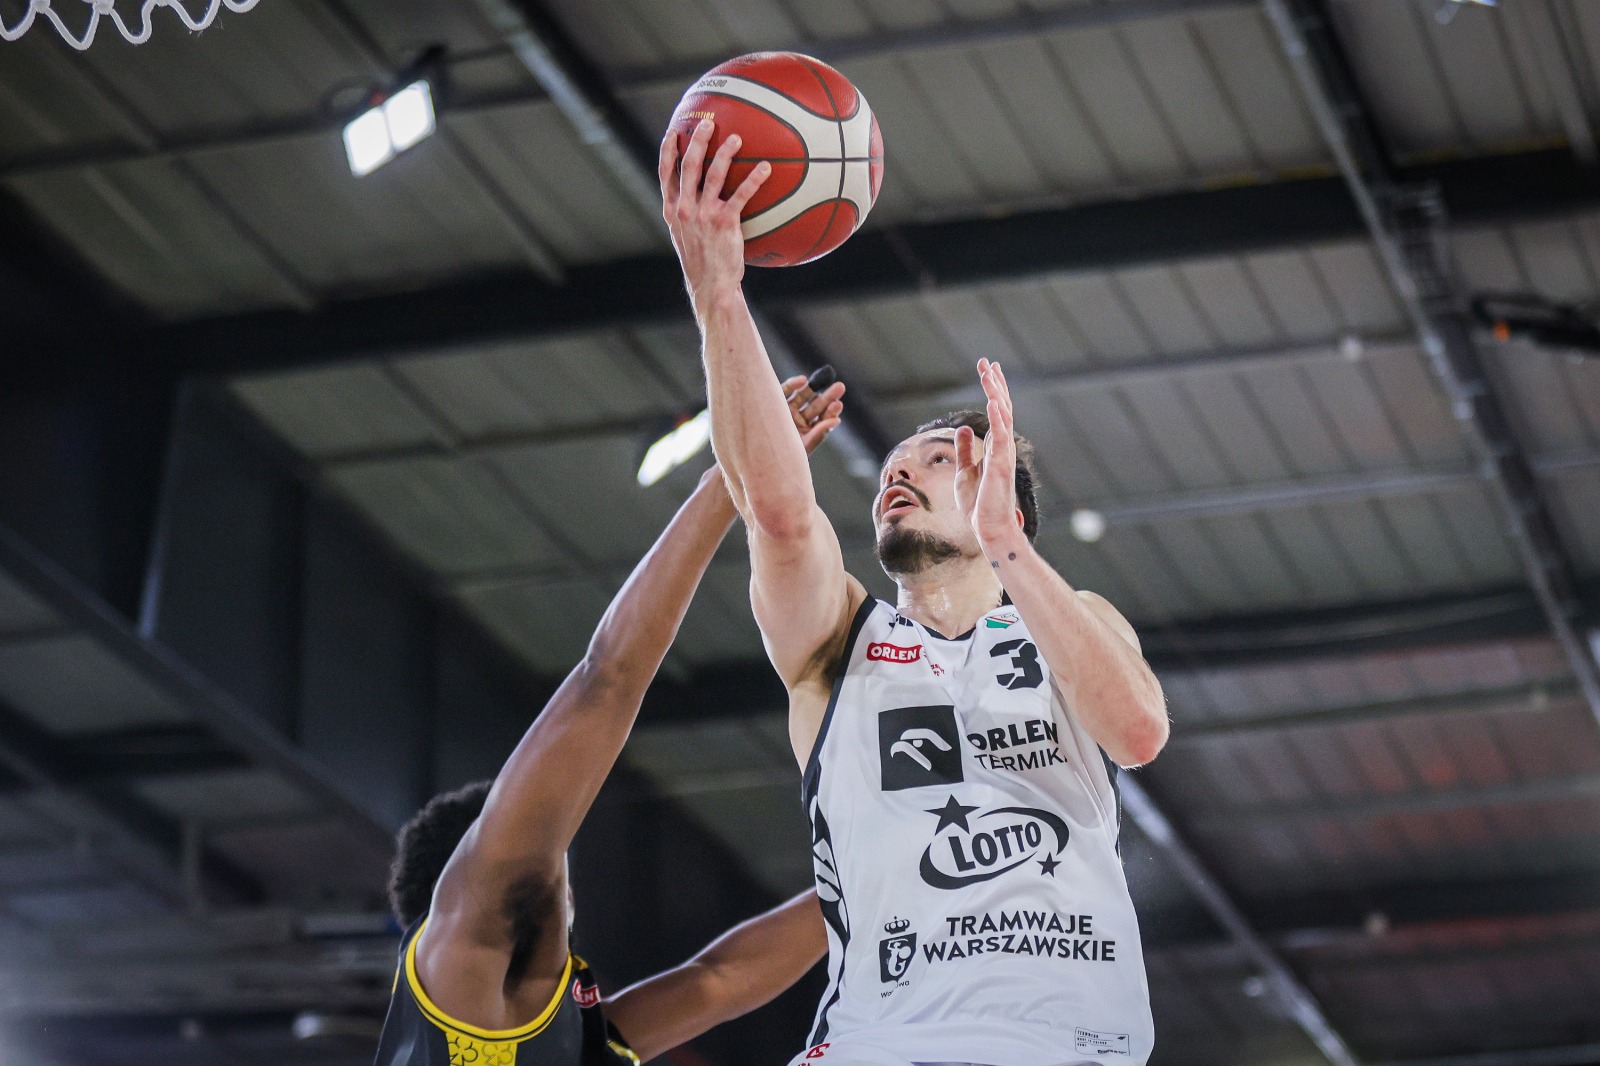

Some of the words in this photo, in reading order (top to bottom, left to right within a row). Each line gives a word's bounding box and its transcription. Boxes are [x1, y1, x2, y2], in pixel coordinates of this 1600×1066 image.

[871, 645, 917, 661] ORLEN
[989, 638, 1044, 690] 3
[966, 719, 1059, 752] ORLEN
[973, 747, 1068, 772] TERMIK
[947, 821, 1042, 872] LOTTO
[945, 910, 1093, 937] TRAMWAJE
[922, 934, 1116, 964] WARSZAWSKIE
